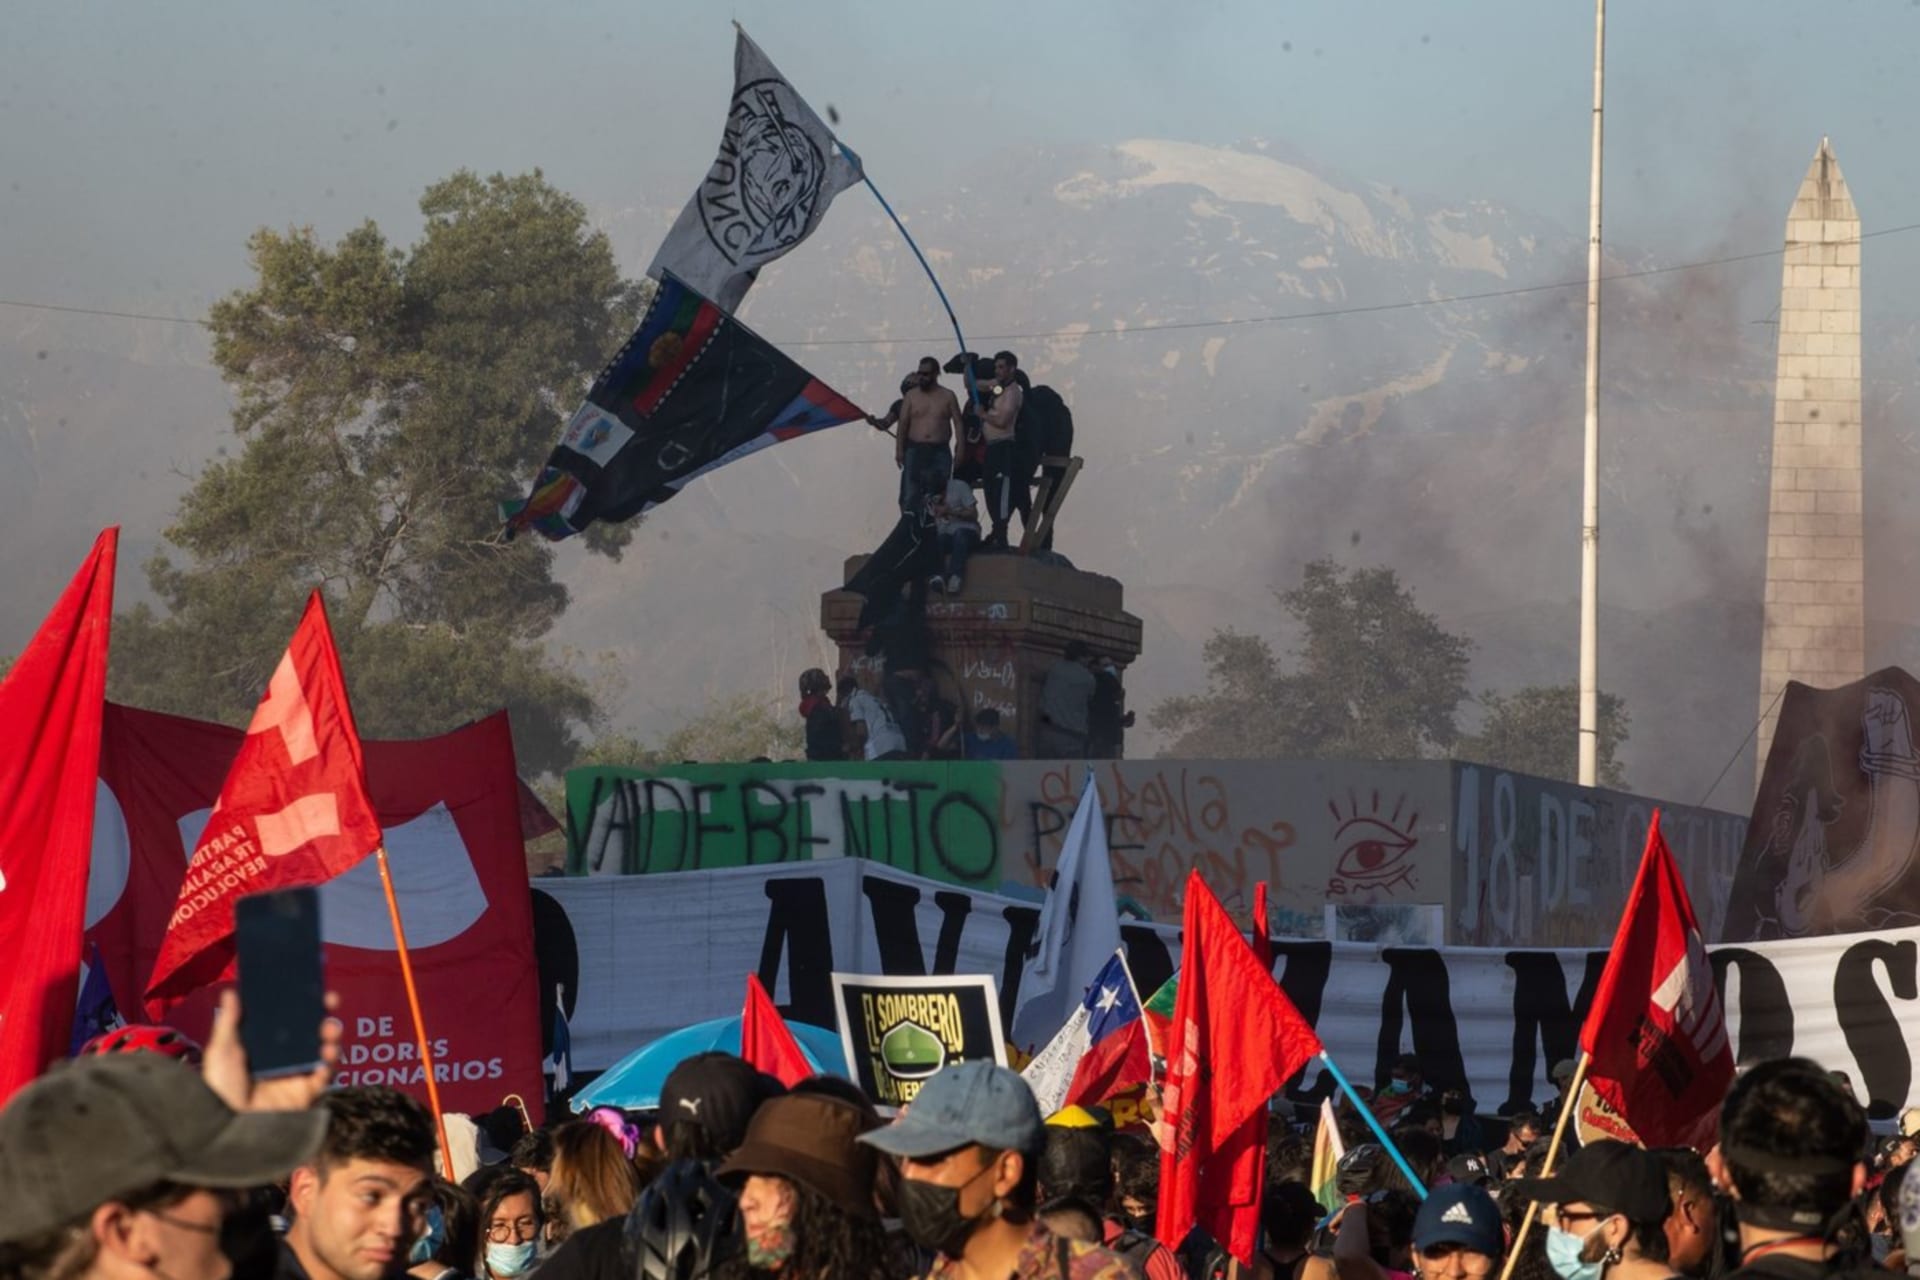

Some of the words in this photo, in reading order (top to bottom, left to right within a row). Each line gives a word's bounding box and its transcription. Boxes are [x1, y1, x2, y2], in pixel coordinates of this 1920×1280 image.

[1457, 765, 1520, 934] 18
[1540, 793, 1596, 911] DE
[357, 1016, 394, 1038] DE
[861, 993, 881, 1053] EL
[877, 993, 964, 1052] SOMBRERO
